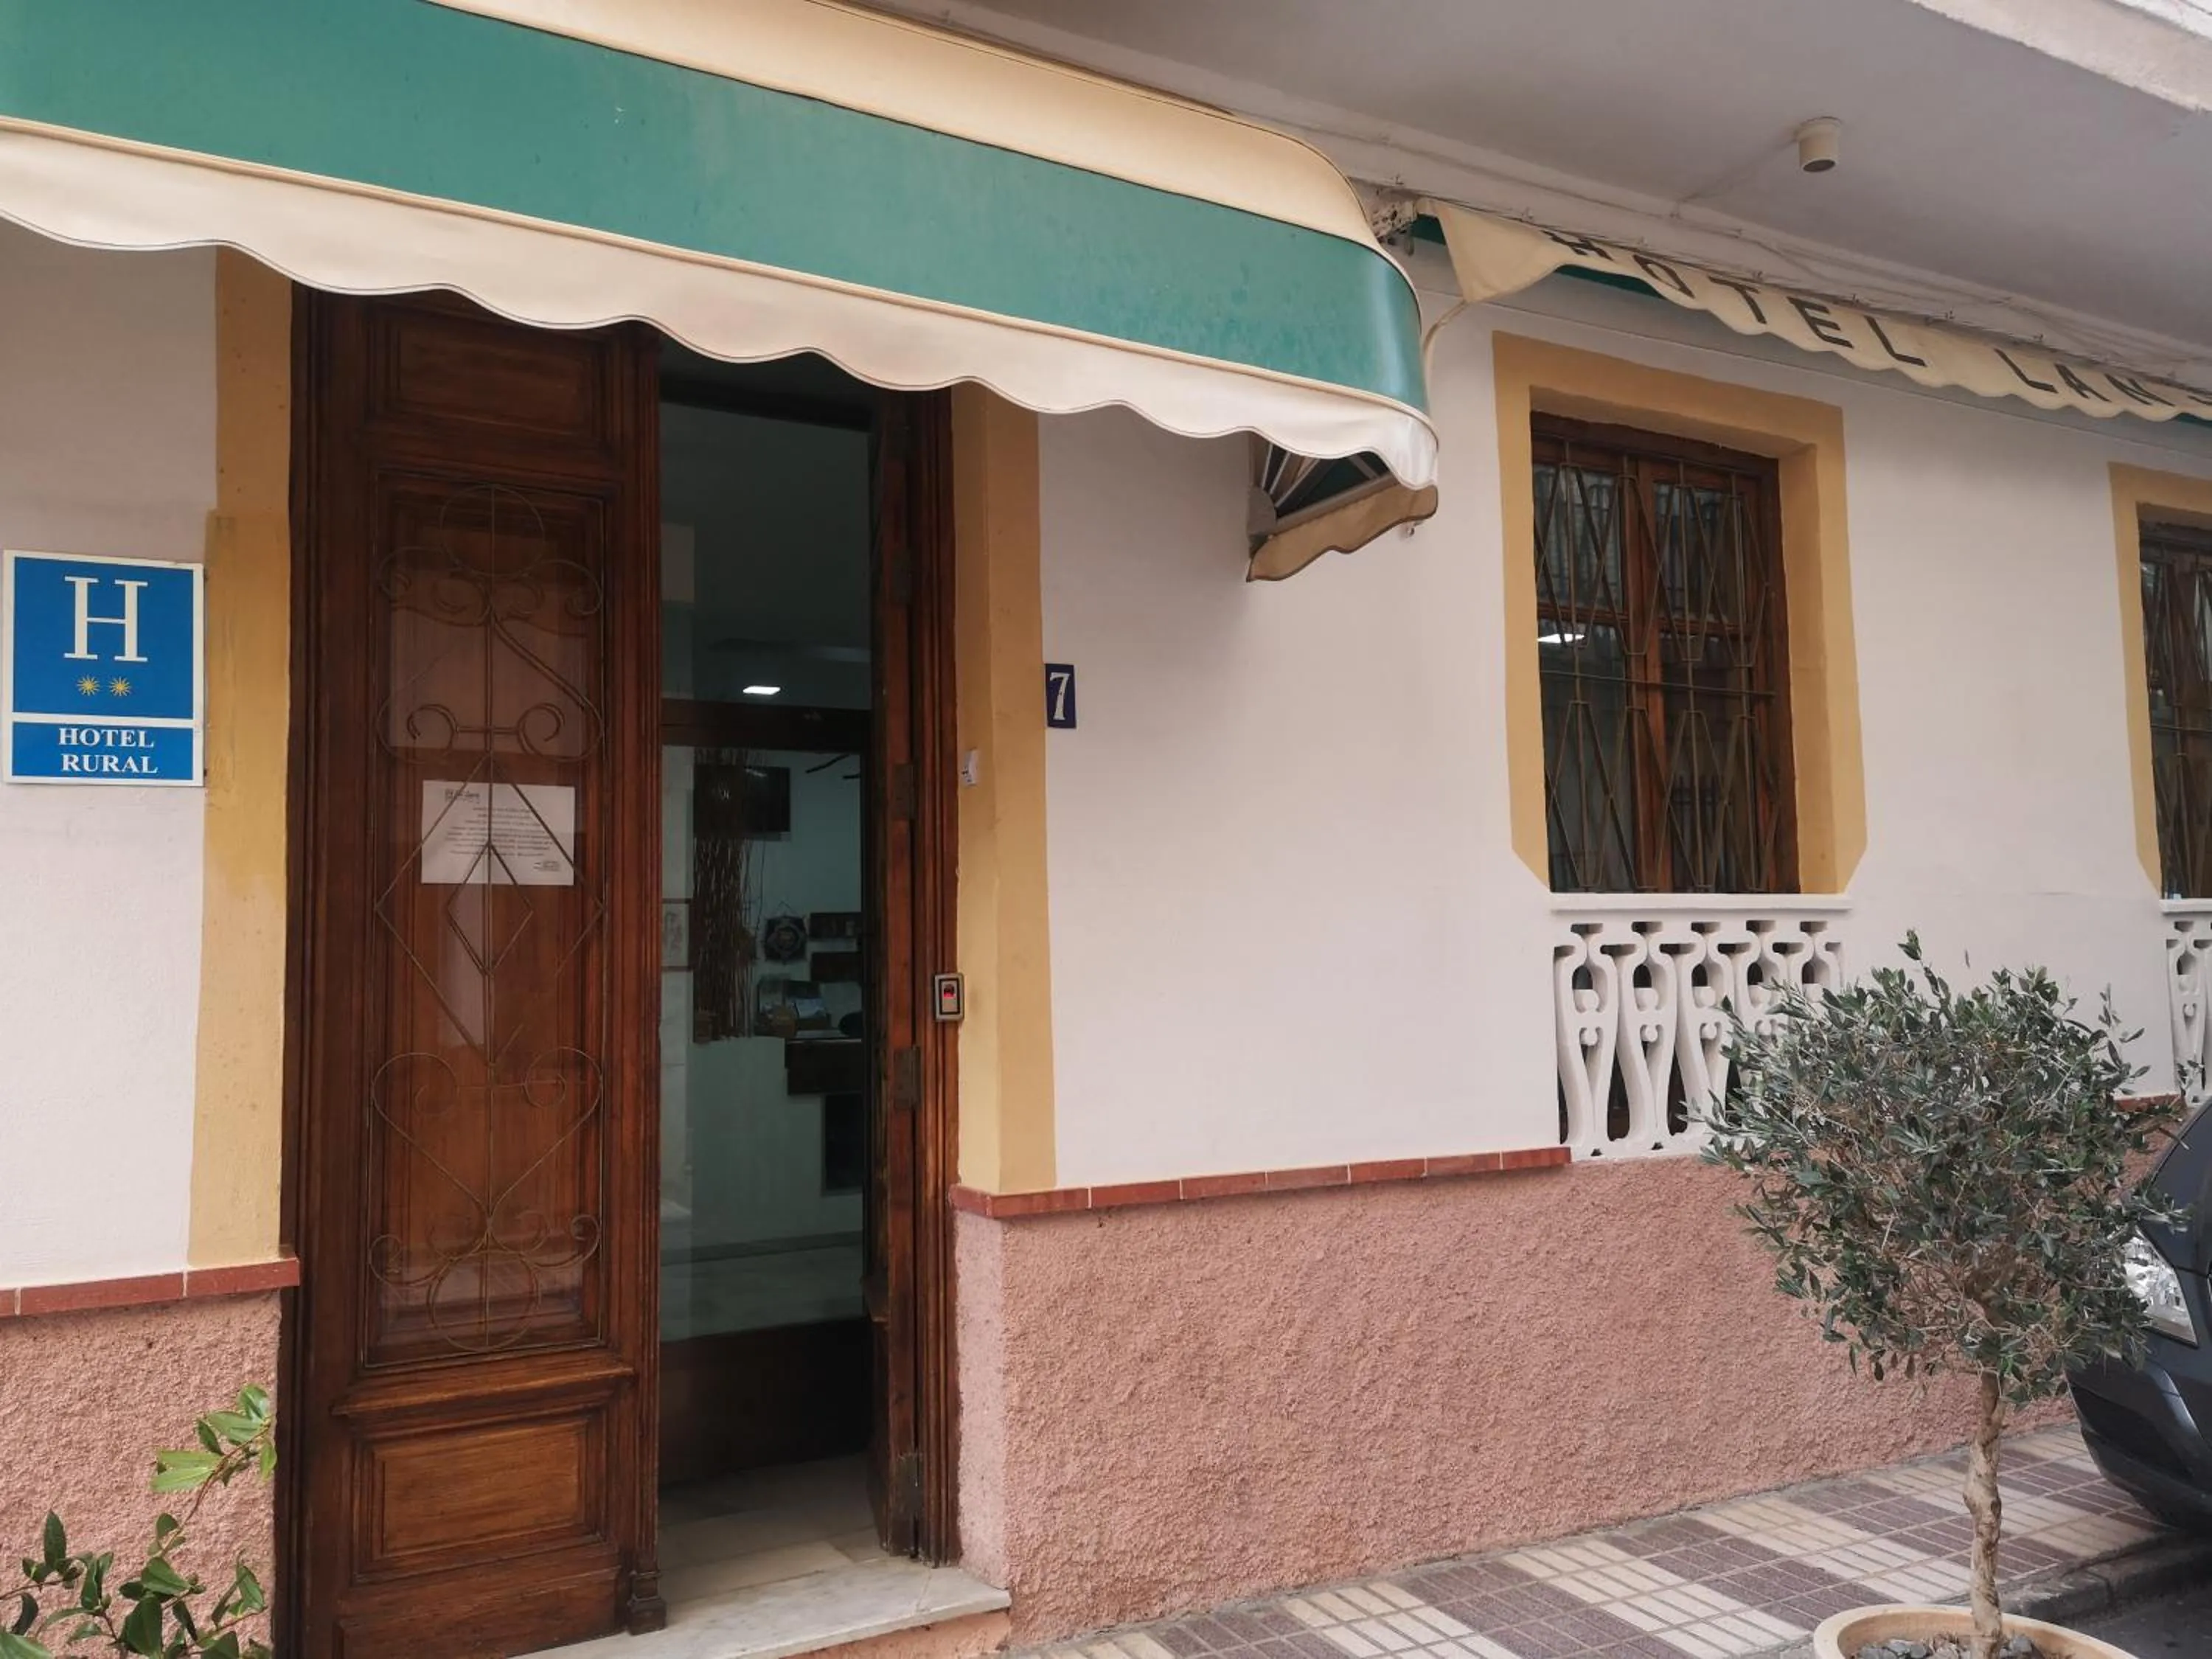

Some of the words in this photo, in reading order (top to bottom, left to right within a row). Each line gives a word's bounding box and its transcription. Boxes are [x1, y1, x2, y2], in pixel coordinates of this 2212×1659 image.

[1540, 229, 1928, 368] HOTEL
[63, 576, 148, 662] H
[1049, 672, 1071, 720] 7
[58, 727, 154, 748] HOTEL
[61, 754, 159, 774] RURAL
